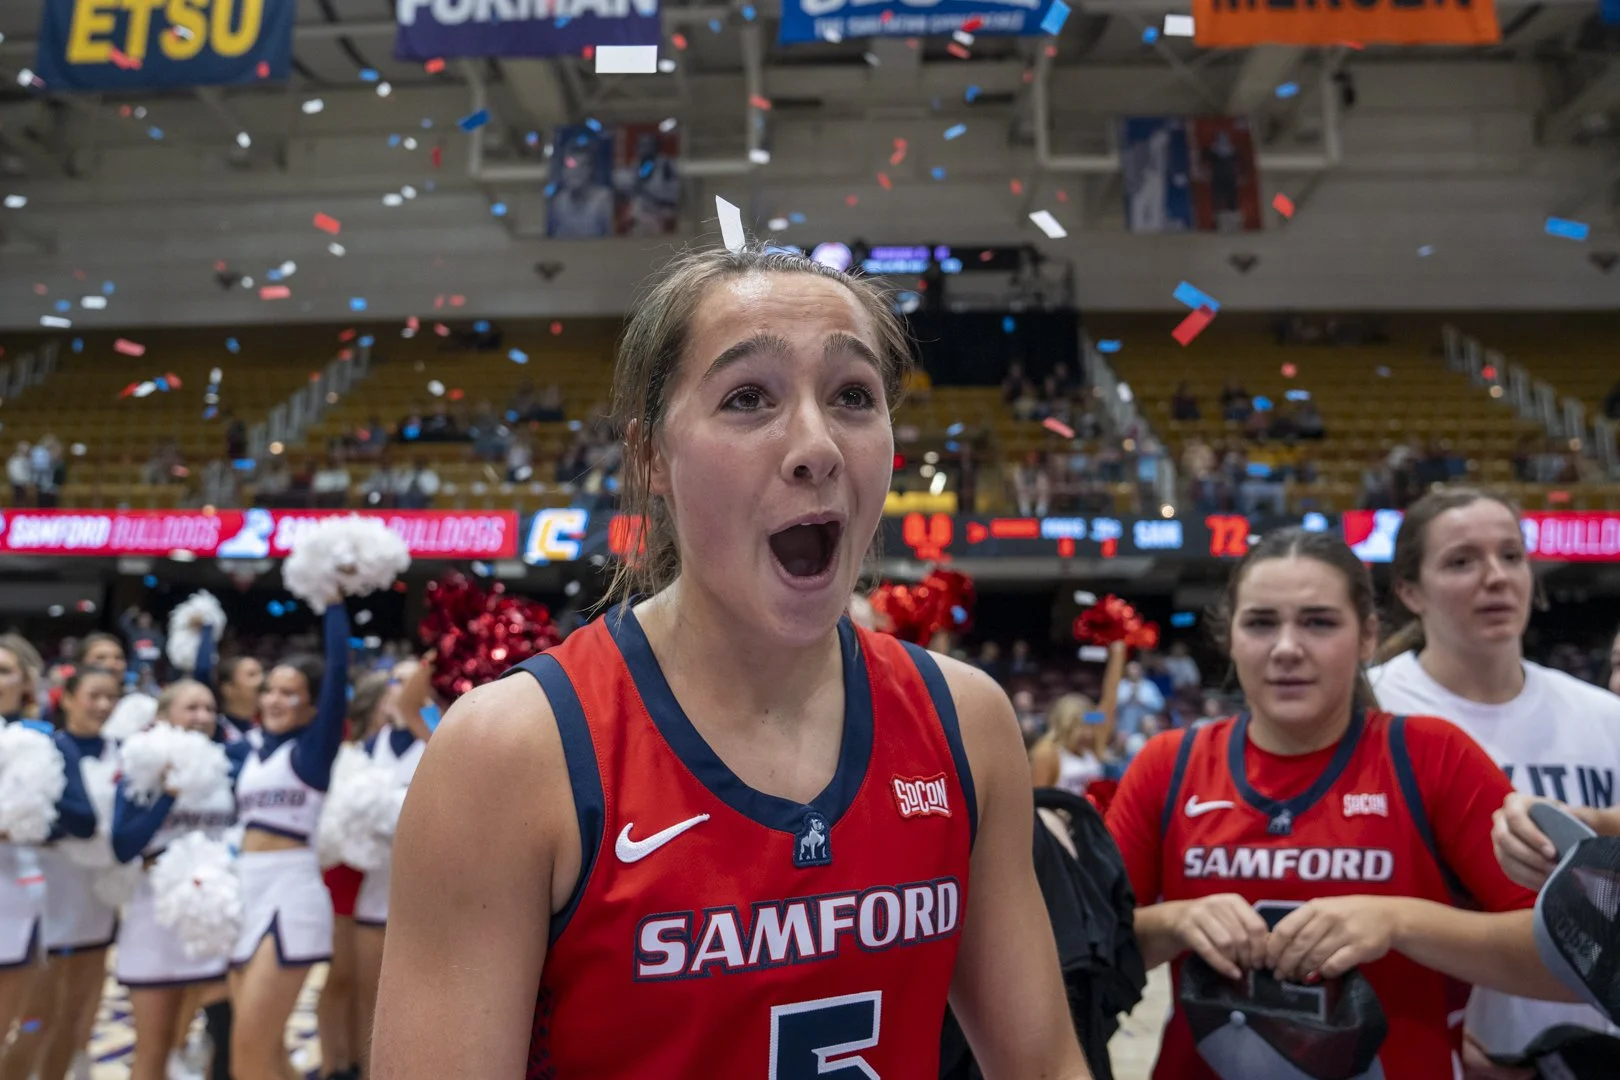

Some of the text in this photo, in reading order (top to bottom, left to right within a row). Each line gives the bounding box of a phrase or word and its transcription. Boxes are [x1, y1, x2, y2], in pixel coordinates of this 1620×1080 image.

[65, 0, 262, 65] ETSU
[7, 515, 111, 549] SAMFORD
[1183, 846, 1394, 882] SAMFORD
[634, 877, 960, 981] SAMFORD
